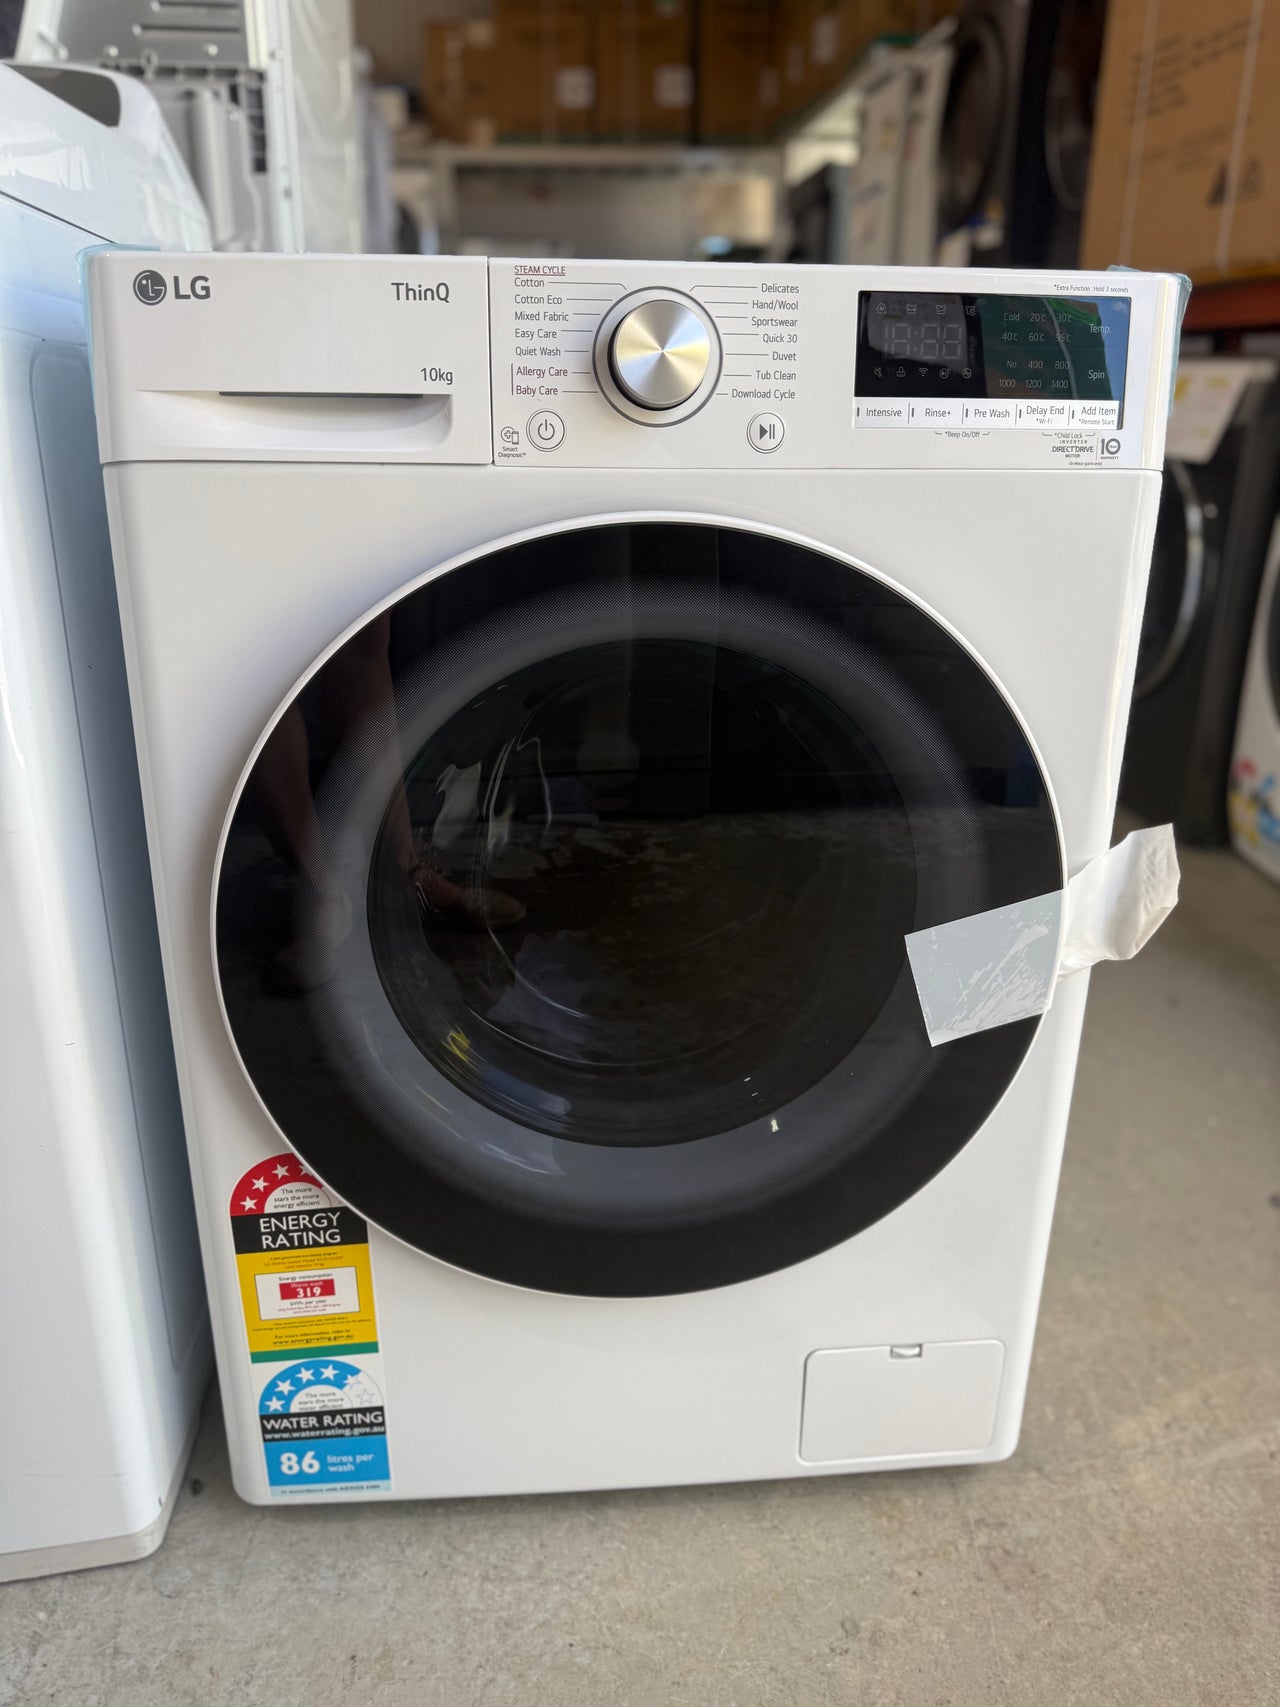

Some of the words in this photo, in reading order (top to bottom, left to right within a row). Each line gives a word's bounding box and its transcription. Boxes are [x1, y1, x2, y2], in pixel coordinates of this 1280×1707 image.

[514, 265, 541, 274] STEAM
[542, 266, 566, 275] CYCLE
[173, 275, 211, 300] LG
[514, 277, 545, 287] Cotton
[391, 282, 450, 303] ThinQ
[761, 283, 800, 294] Delicates
[514, 294, 545, 304] Cotton
[547, 295, 563, 305] Eco
[752, 299, 799, 310] Hand/Wool
[514, 311, 540, 321] Mixed
[543, 312, 570, 322] Fabric
[751, 316, 799, 328] Sportswear
[1004, 313, 1020, 322] Cold
[515, 328, 535, 340] Easy
[537, 329, 557, 339] Care
[1089, 324, 1112, 335] Temp.
[763, 333, 785, 344] Quick
[786, 334, 798, 343] 30
[515, 347, 537, 357] Quiet
[540, 347, 561, 356] Wash
[772, 351, 797, 361] Duvet
[1007, 361, 1017, 369] No
[1028, 361, 1043, 369] 400
[1055, 361, 1070, 370] 800
[420, 367, 453, 385] 10kg
[516, 366, 546, 378] Allergy
[548, 367, 568, 376] Care
[756, 370, 771, 380] Tub
[773, 370, 797, 380] Clean
[1088, 370, 1105, 380] Spin
[999, 379, 1016, 388] 1000
[1025, 380, 1041, 389] 1200
[1052, 380, 1068, 389] 1400
[516, 385, 536, 397] Baby
[539, 386, 558, 395] Care
[731, 388, 771, 399] Download
[773, 389, 796, 401] Cycle
[866, 408, 902, 417] Intensive
[925, 408, 951, 418] Rinse+
[974, 409, 987, 418] Pre
[989, 409, 1010, 418] Wash
[1026, 405, 1048, 418] Delay
[1050, 406, 1065, 415] End
[1081, 406, 1097, 415] Add
[1099, 407, 1117, 416] Item
[961, 430, 980, 438] On/Off
[1100, 438, 1121, 455] 10
[260, 1211, 341, 1233] ENERGY
[262, 1229, 341, 1249] RATING
[296, 1286, 322, 1298] 319
[263, 1416, 319, 1430] WATER
[323, 1411, 383, 1427] RATING
[264, 1425, 385, 1440] www.waterrating.gov.au
[280, 1450, 320, 1475] 86
[327, 1454, 353, 1464] litres
[356, 1453, 374, 1464] per
[328, 1463, 355, 1473] wash
